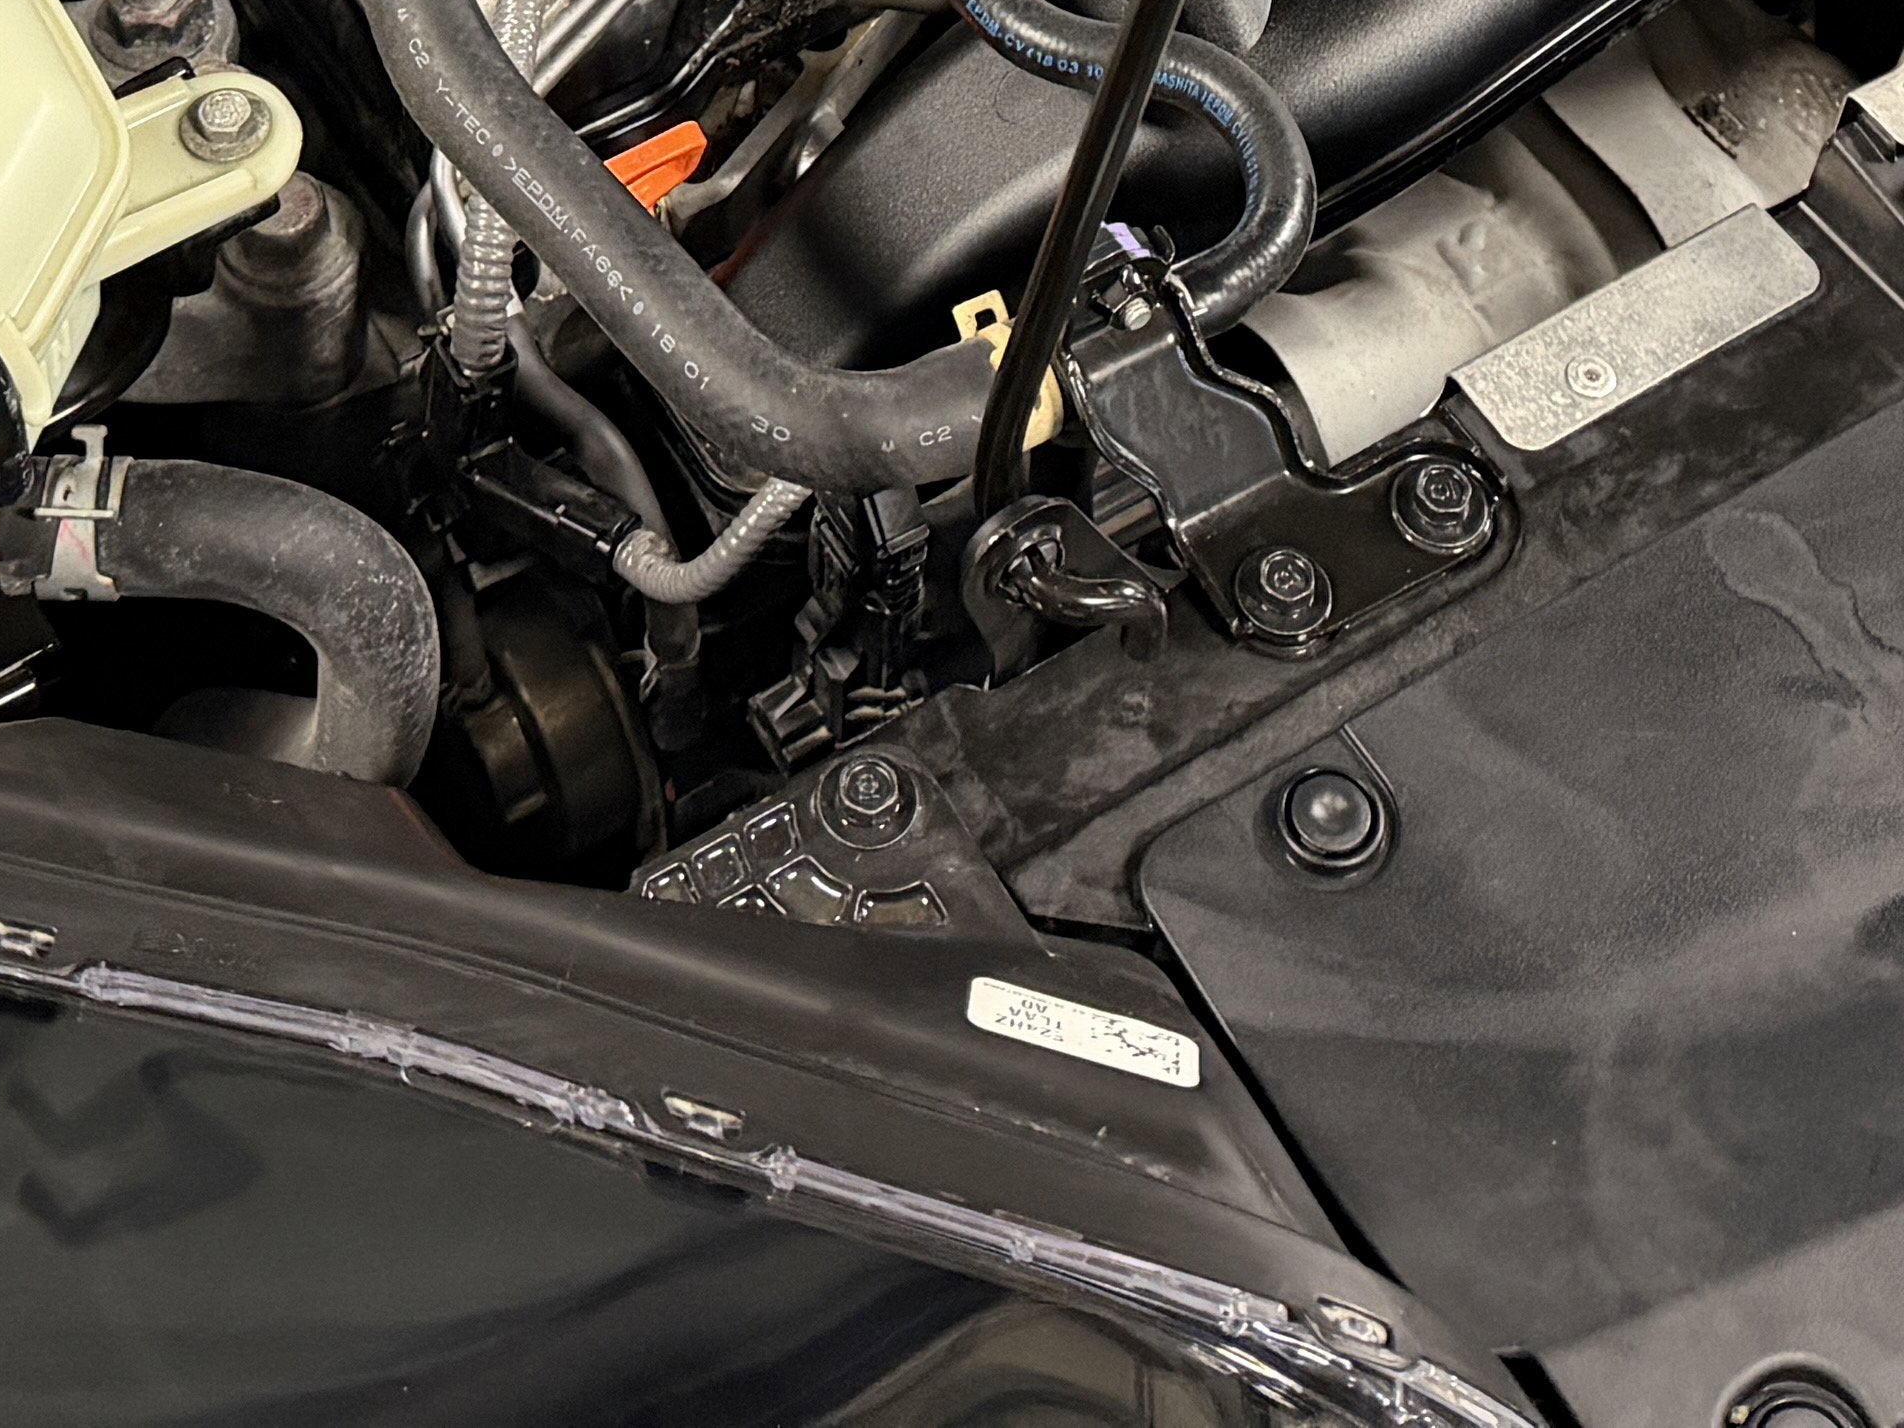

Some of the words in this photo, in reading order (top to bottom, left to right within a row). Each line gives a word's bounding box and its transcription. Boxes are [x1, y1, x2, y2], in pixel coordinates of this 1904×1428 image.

[1057, 59, 1079, 74] 03
[1085, 63, 1104, 79] 10
[1154, 71, 1200, 97] ASHITA
[408, 38, 430, 69] C2
[436, 78, 491, 145] Y-TEC
[651, 323, 676, 353] 18
[684, 360, 710, 391] 01
[751, 414, 792, 442] 30
[919, 425, 952, 446] C2
